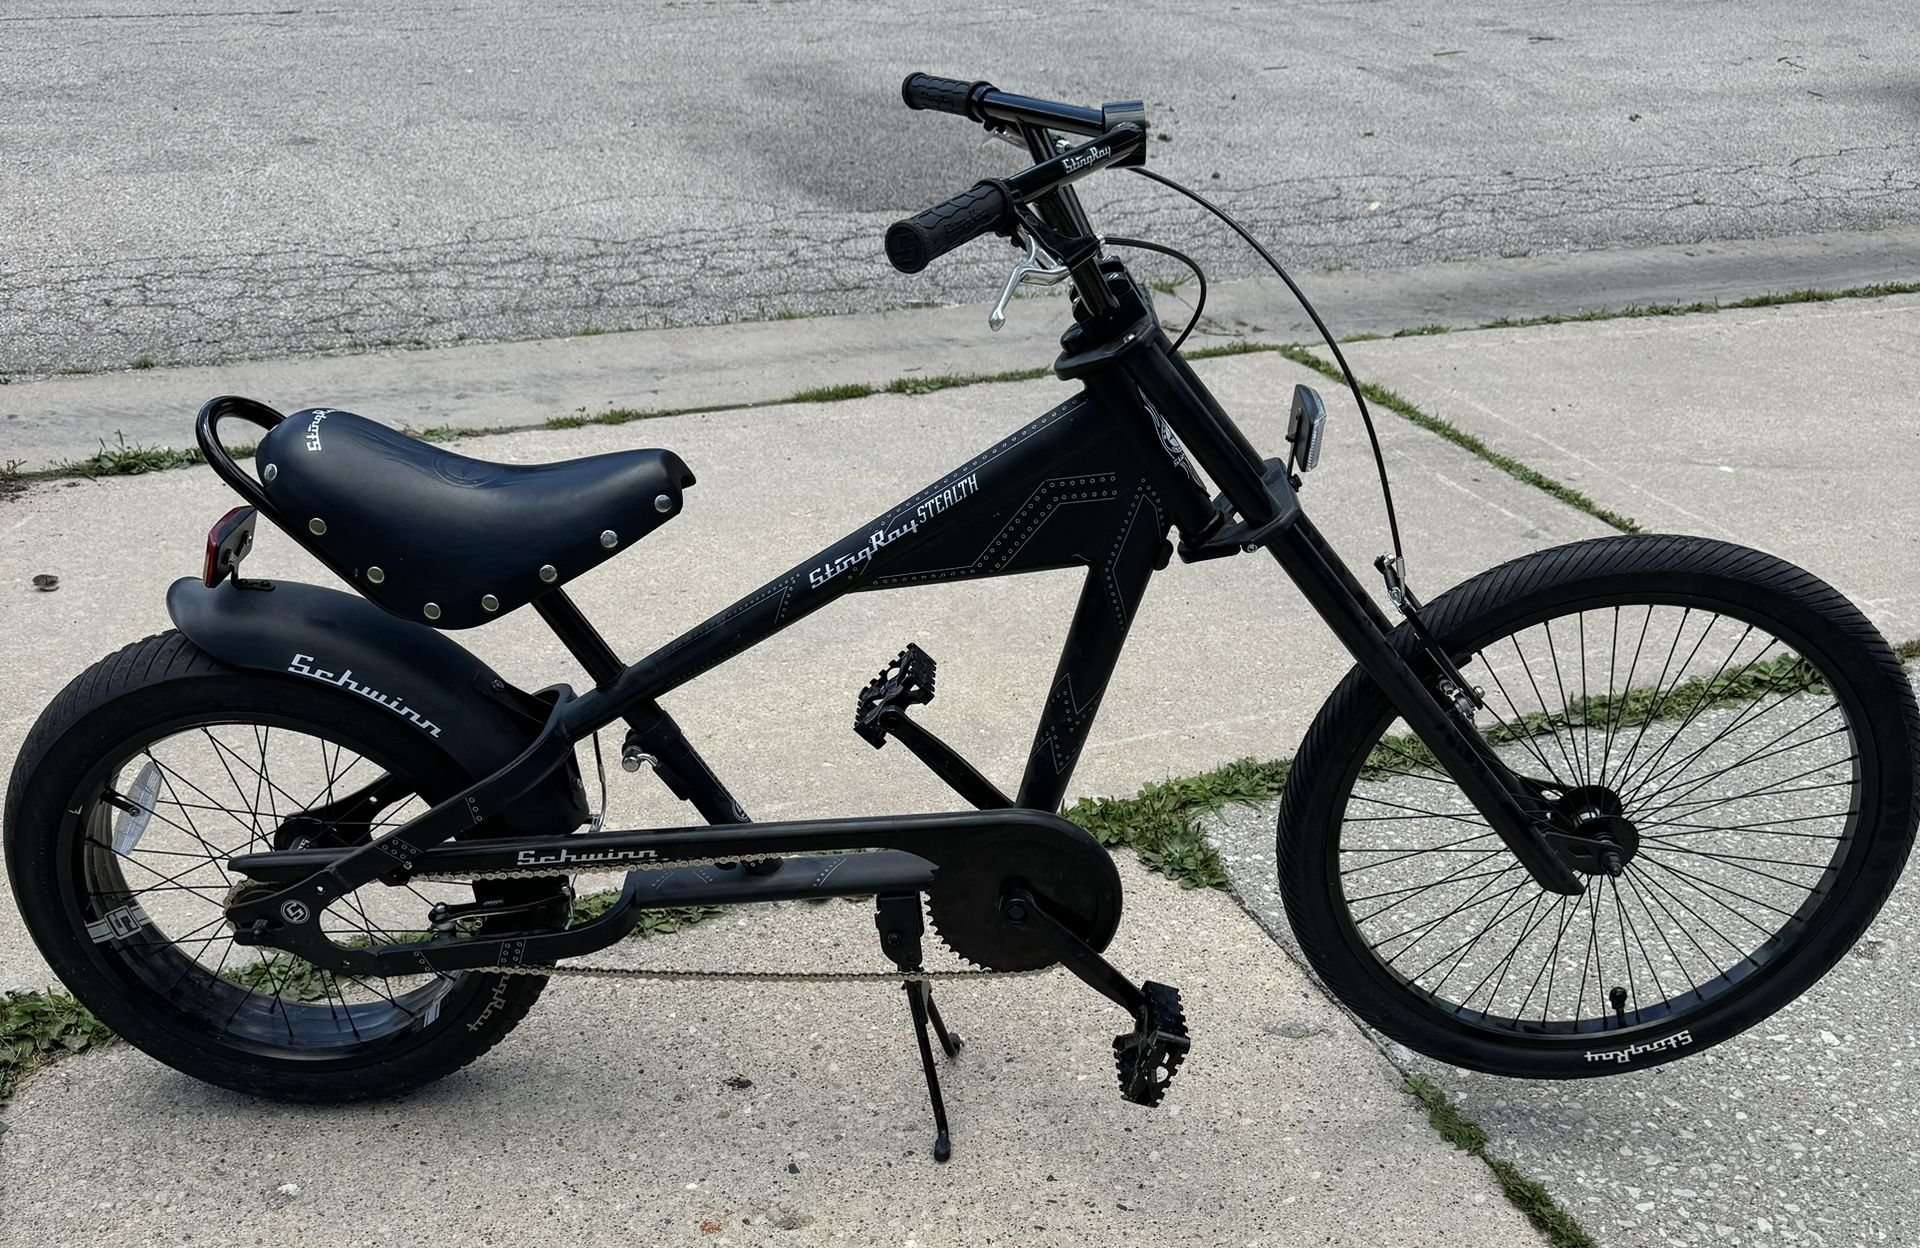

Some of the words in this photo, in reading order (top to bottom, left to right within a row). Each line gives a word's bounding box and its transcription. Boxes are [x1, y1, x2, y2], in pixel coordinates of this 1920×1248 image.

[1063, 146, 1111, 174] StingRay
[809, 520, 918, 589] StingRay
[917, 473, 979, 523] STEALTH
[288, 653, 442, 738] Schwinn
[517, 849, 657, 865] Schwinn
[1584, 1029, 1692, 1063] StingRay
